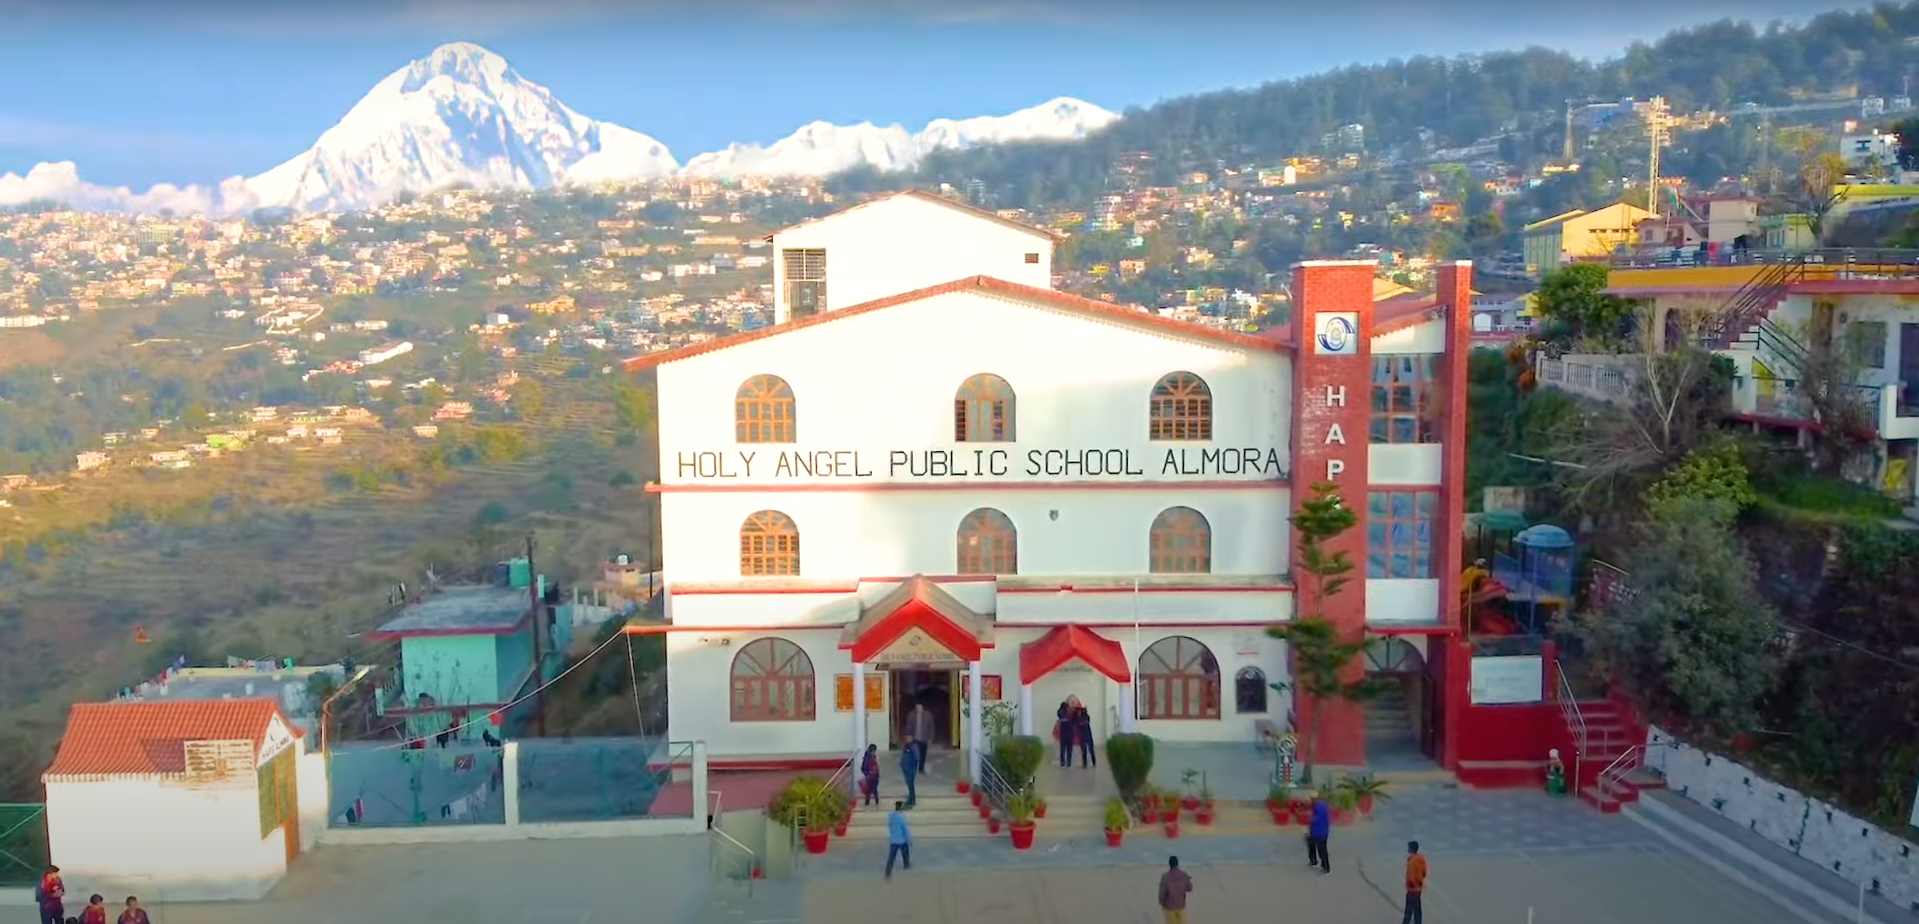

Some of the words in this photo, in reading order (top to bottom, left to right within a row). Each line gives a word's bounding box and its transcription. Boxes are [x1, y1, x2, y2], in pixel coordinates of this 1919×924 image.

[678, 451, 756, 478] HOLY
[775, 451, 873, 477] ANGEL
[890, 450, 1008, 476] PUBLIC
[1026, 449, 1143, 476] SCHOOL
[1162, 448, 1281, 475] ALMORA
